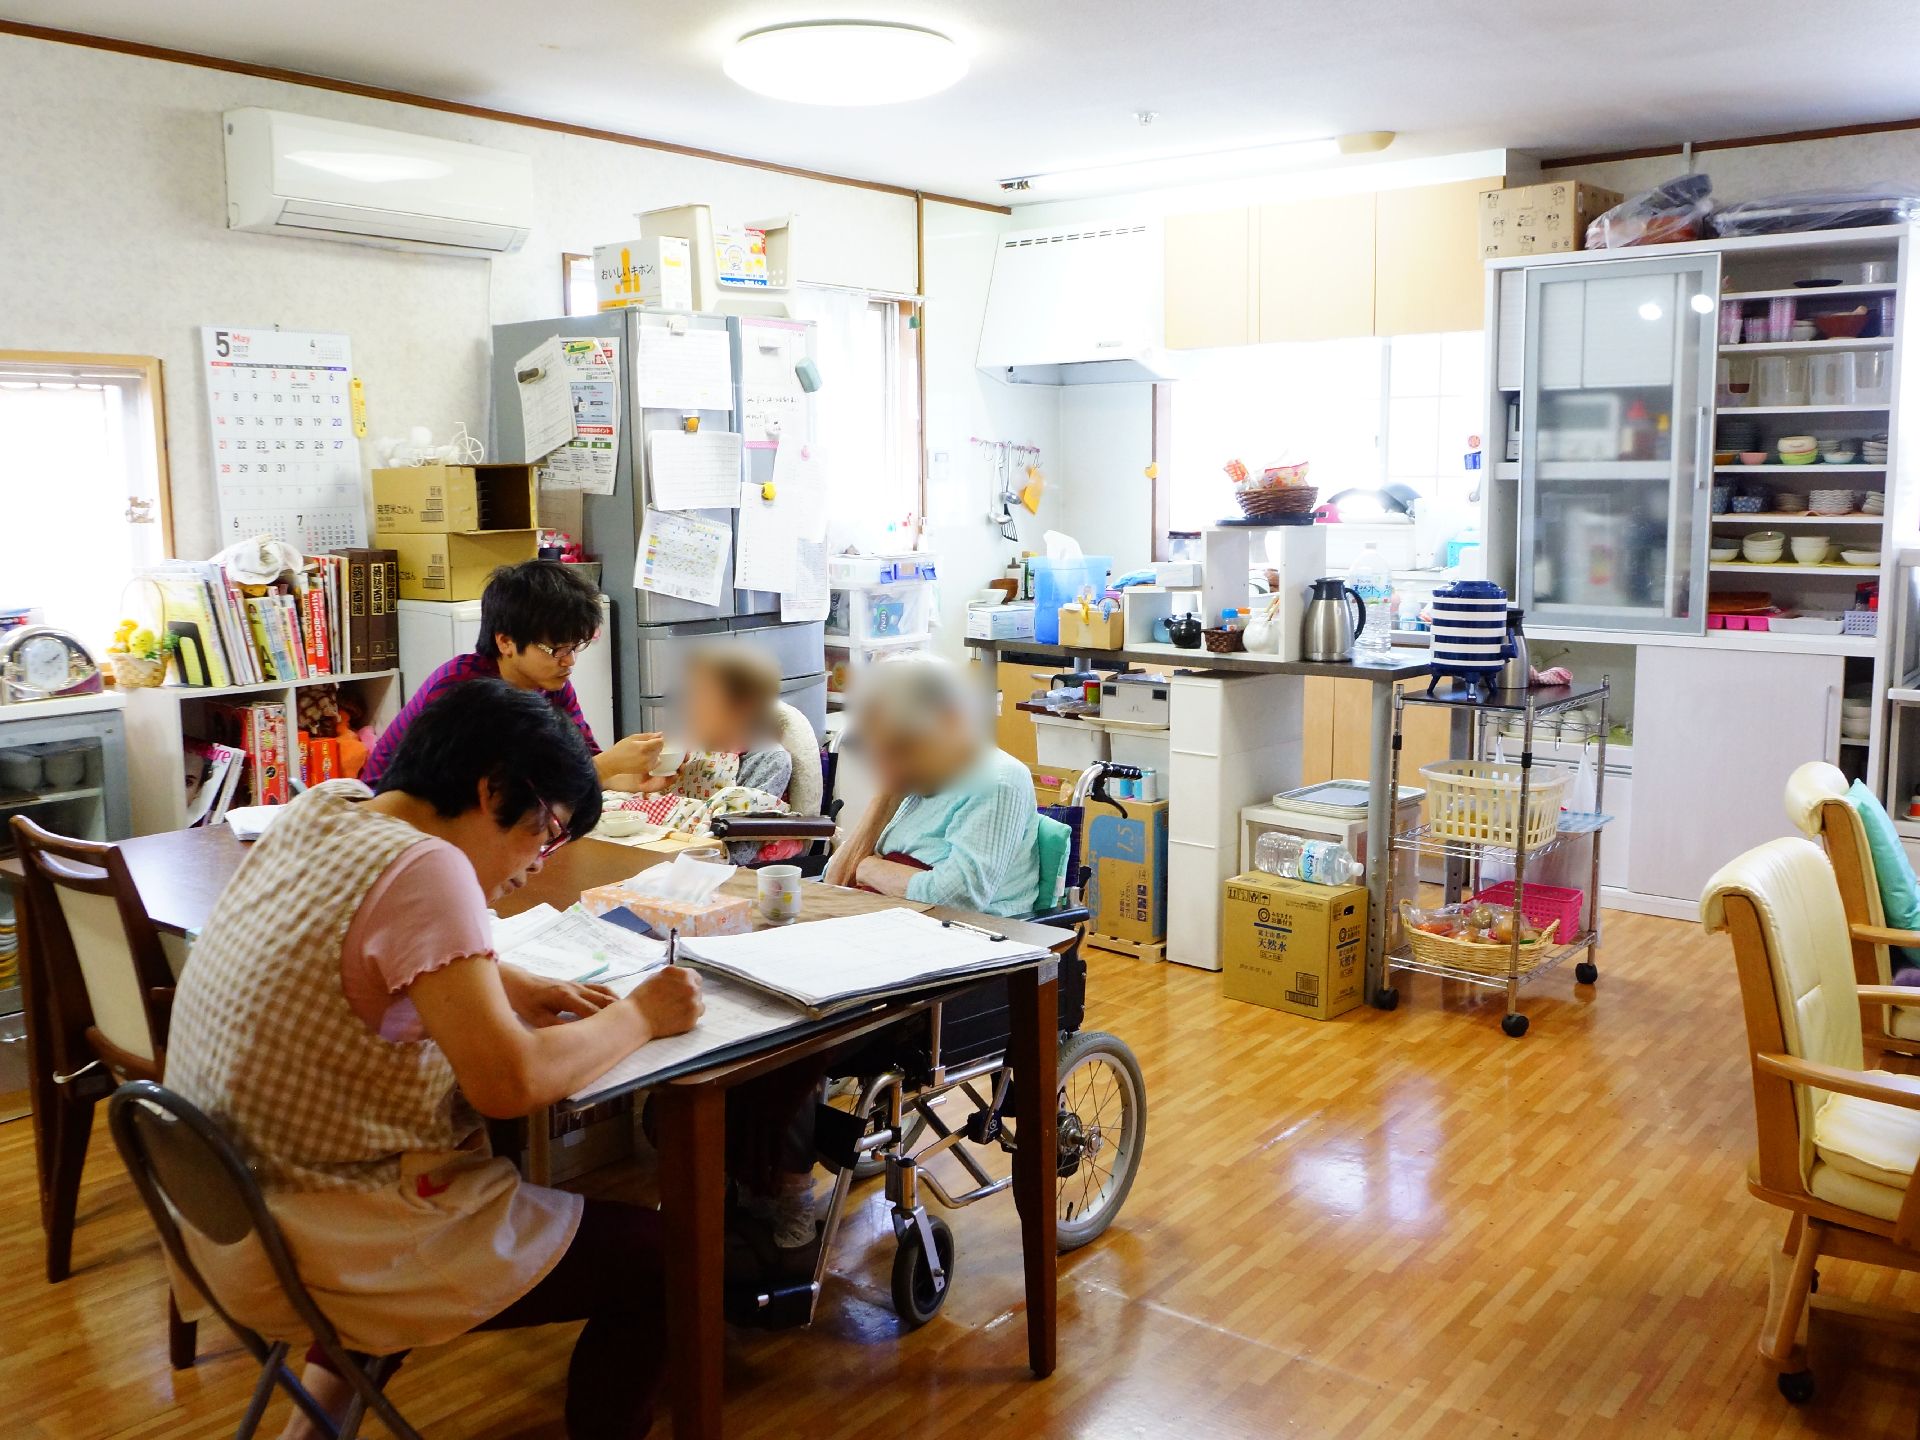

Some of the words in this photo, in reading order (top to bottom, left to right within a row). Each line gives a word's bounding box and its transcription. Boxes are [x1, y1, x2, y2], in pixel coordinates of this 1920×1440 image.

[215, 331, 230, 357] 5
[232, 333, 250, 344] May
[251, 369, 257, 379] 2
[272, 370, 277, 380] 3
[290, 371, 297, 380] 4
[309, 372, 316, 381] 5
[329, 373, 334, 382] 6
[233, 392, 239, 402] 8
[253, 393, 258, 402] 9
[273, 394, 282, 403] 10
[292, 394, 301, 403] 11
[311, 395, 321, 404] 12
[331, 395, 340, 404] 13
[217, 416, 226, 425] 14
[235, 416, 244, 426] 15
[255, 417, 264, 426] 16
[274, 417, 283, 426] 17
[293, 417, 303, 427] 18
[313, 417, 322, 427] 19
[332, 418, 342, 427] 20
[219, 440, 227, 449] 21
[237, 440, 247, 450] 22
[256, 440, 266, 450] 23
[275, 440, 286, 450] 24
[295, 440, 305, 450] 25
[314, 440, 325, 450] 26
[333, 440, 343, 450] 27
[221, 464, 231, 473] 28
[239, 464, 248, 473] 29
[257, 464, 268, 473] 30
[277, 464, 286, 473] 31
[233, 516, 239, 529] 6
[296, 514, 303, 526] 7
[375, 644, 381, 653] 2
[1258, 937, 1287, 953] 天然水
